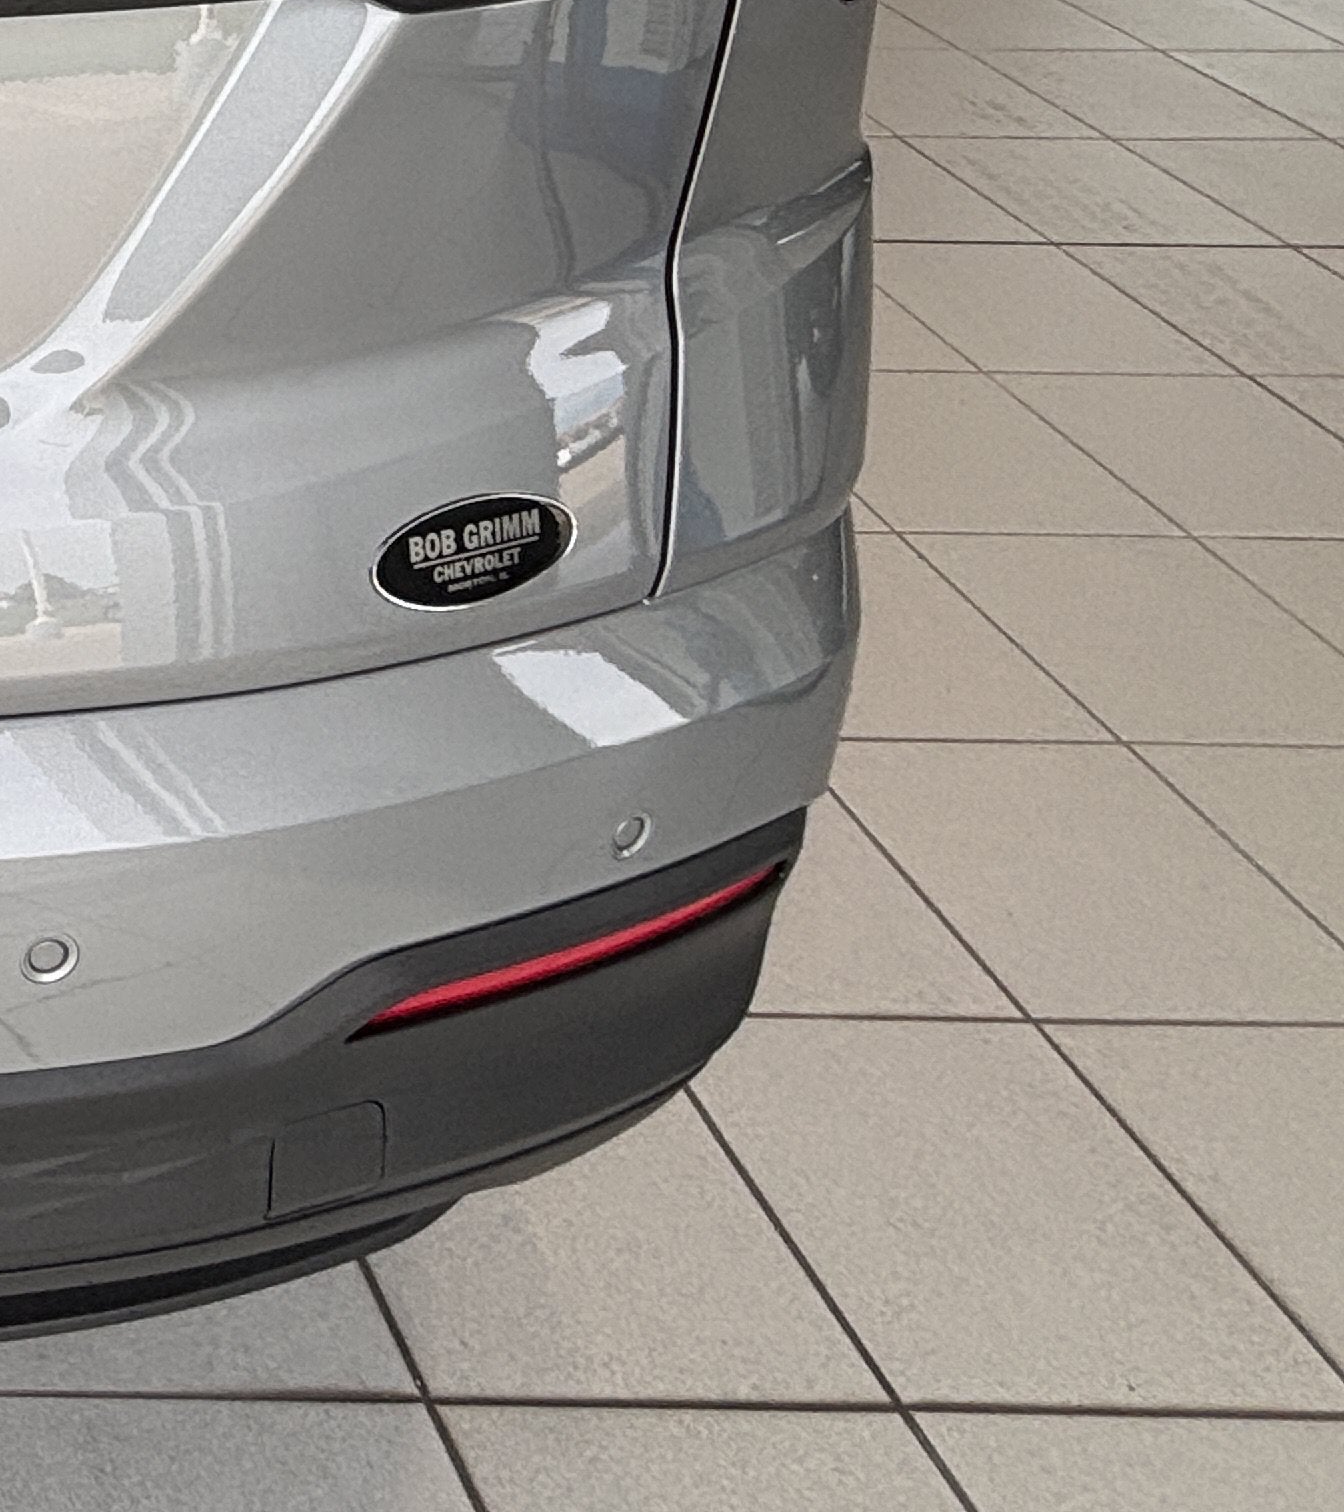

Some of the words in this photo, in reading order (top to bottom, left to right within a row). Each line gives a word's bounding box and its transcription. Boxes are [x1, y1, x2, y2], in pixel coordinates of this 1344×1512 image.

[408, 528, 458, 564] BOB
[462, 508, 541, 550] GRIMM
[433, 547, 521, 584] CHEVROLET
